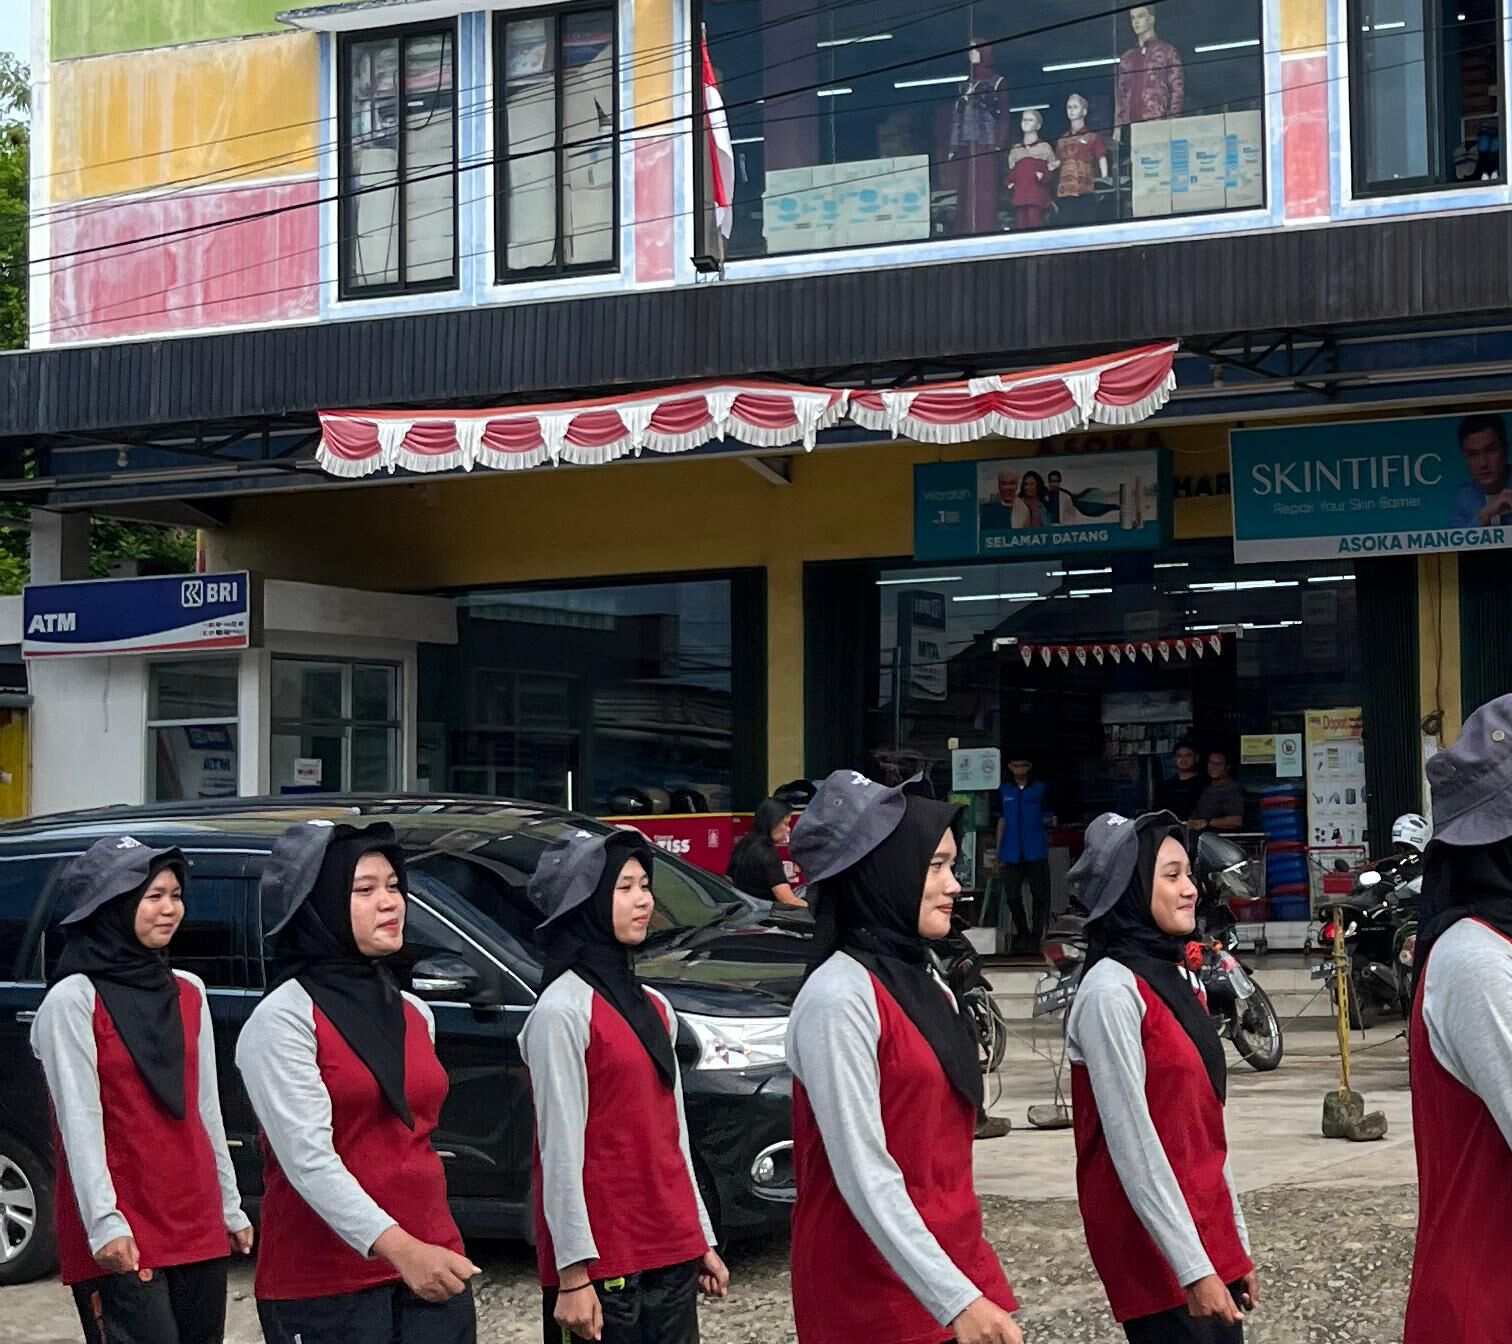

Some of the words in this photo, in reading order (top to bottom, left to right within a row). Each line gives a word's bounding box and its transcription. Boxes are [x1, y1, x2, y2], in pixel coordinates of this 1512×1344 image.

[1251, 452, 1444, 497] SKINTIFIC
[984, 532, 1049, 550] SELAMAT
[1052, 529, 1109, 546] DATANG
[1338, 534, 1402, 554] ASOKA
[1407, 528, 1505, 549] MANGGAR
[207, 582, 238, 603] BRI
[27, 612, 76, 634] ATM
